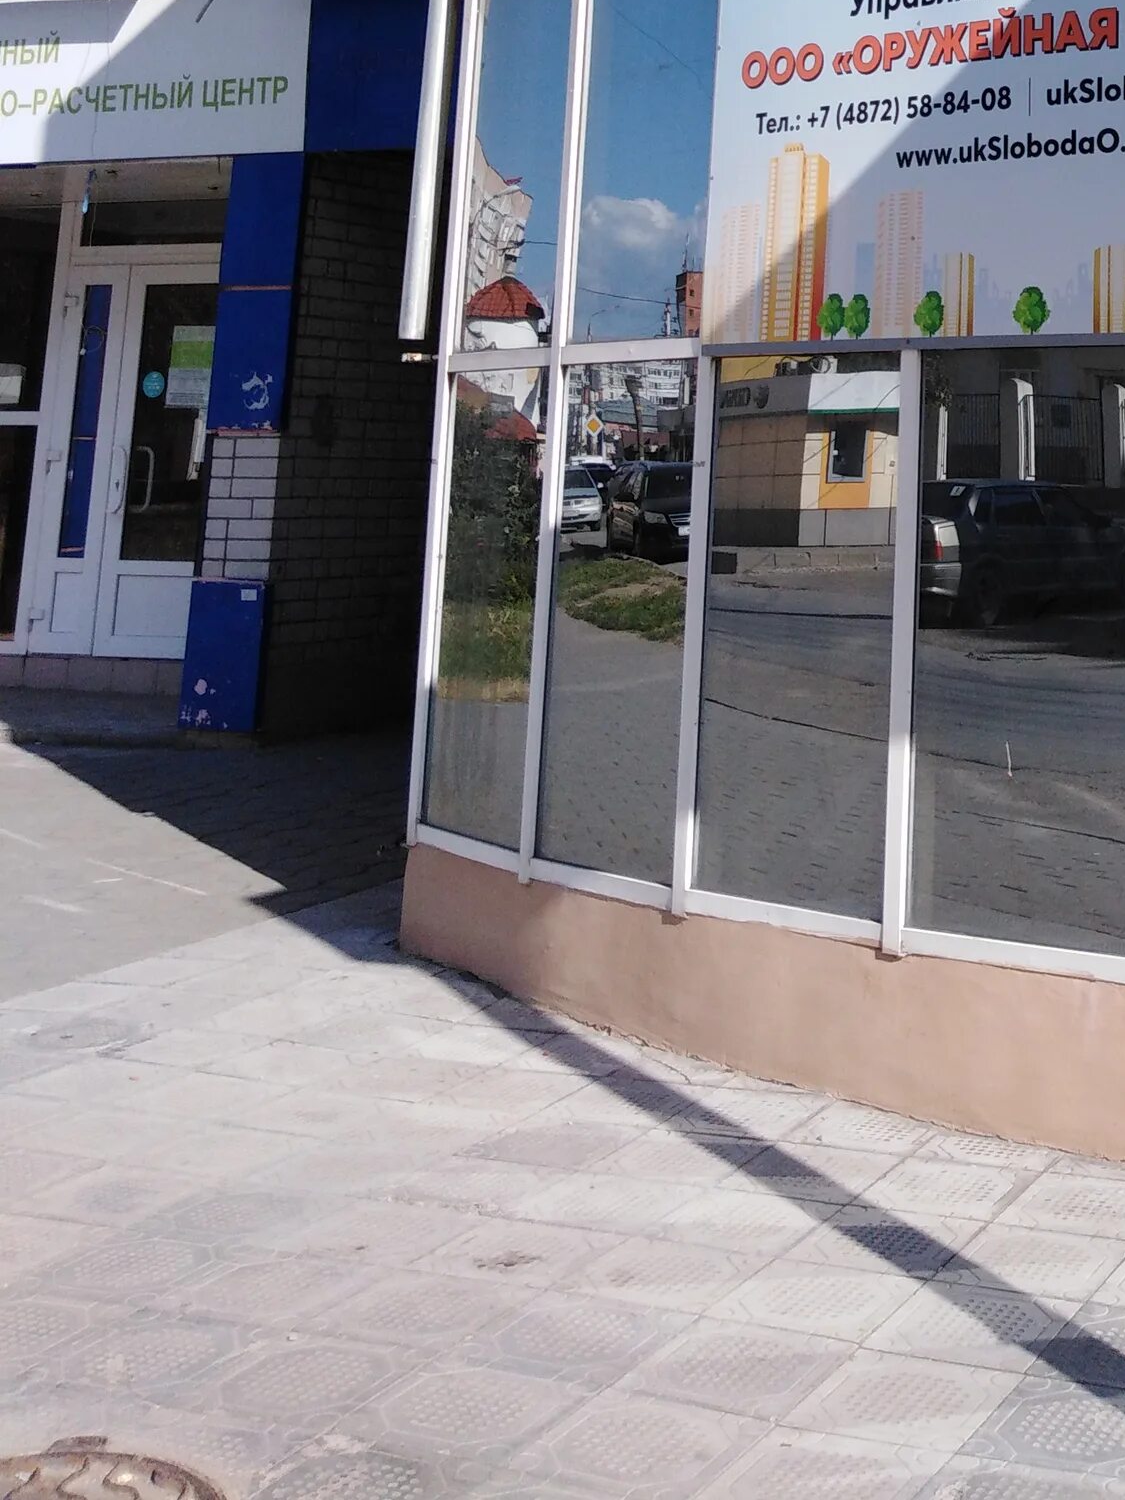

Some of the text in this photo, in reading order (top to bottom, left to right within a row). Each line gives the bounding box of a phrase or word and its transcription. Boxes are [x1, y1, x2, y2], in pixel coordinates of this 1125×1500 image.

[0, 30, 61, 66] НЫЙ
[742, 43, 824, 89] ООО
[833, 7, 1119, 77] «ОРУЖЕЙНАЯ
[202, 76, 289, 112] ЦЕНТР
[756, 86, 1012, 135] Тел.: +7 (4872) 58-84-08
